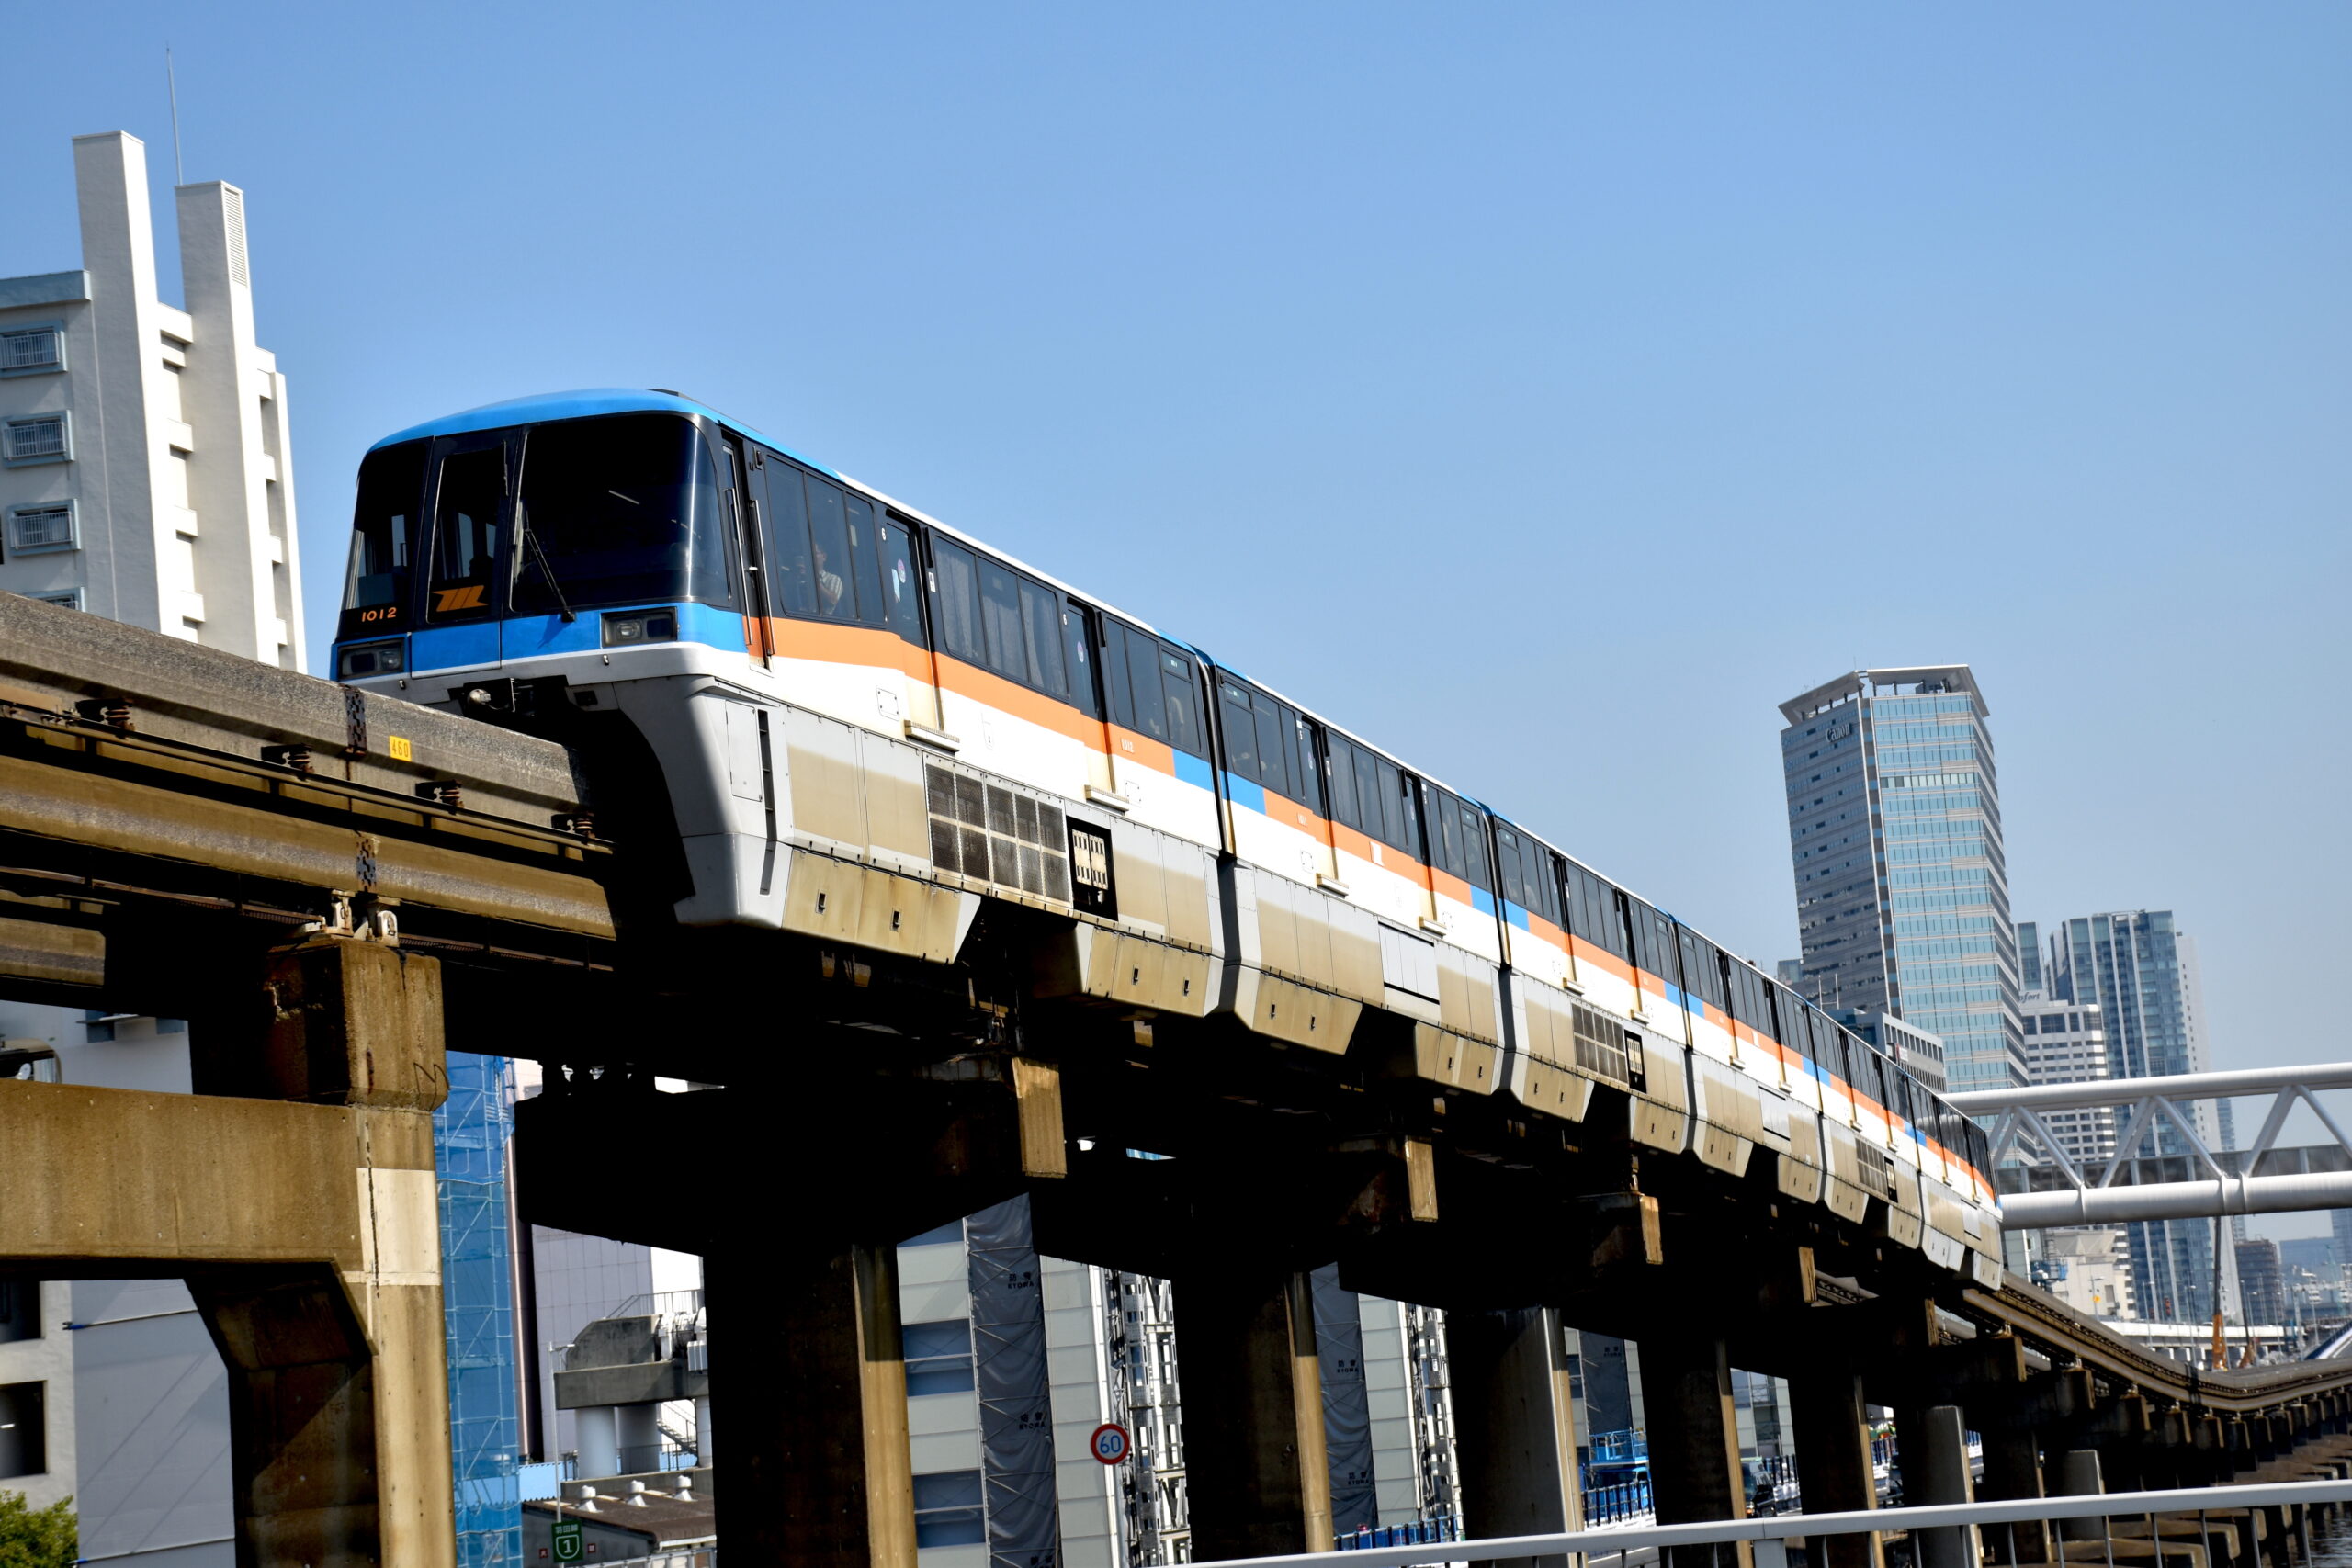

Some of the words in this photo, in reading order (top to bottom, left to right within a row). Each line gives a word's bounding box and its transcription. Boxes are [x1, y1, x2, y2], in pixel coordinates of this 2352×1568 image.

[361, 606, 397, 623] 1012
[1826, 723, 1850, 743] Canon
[1100, 1435, 1122, 1454] 60
[562, 1539, 573, 1554] 1
